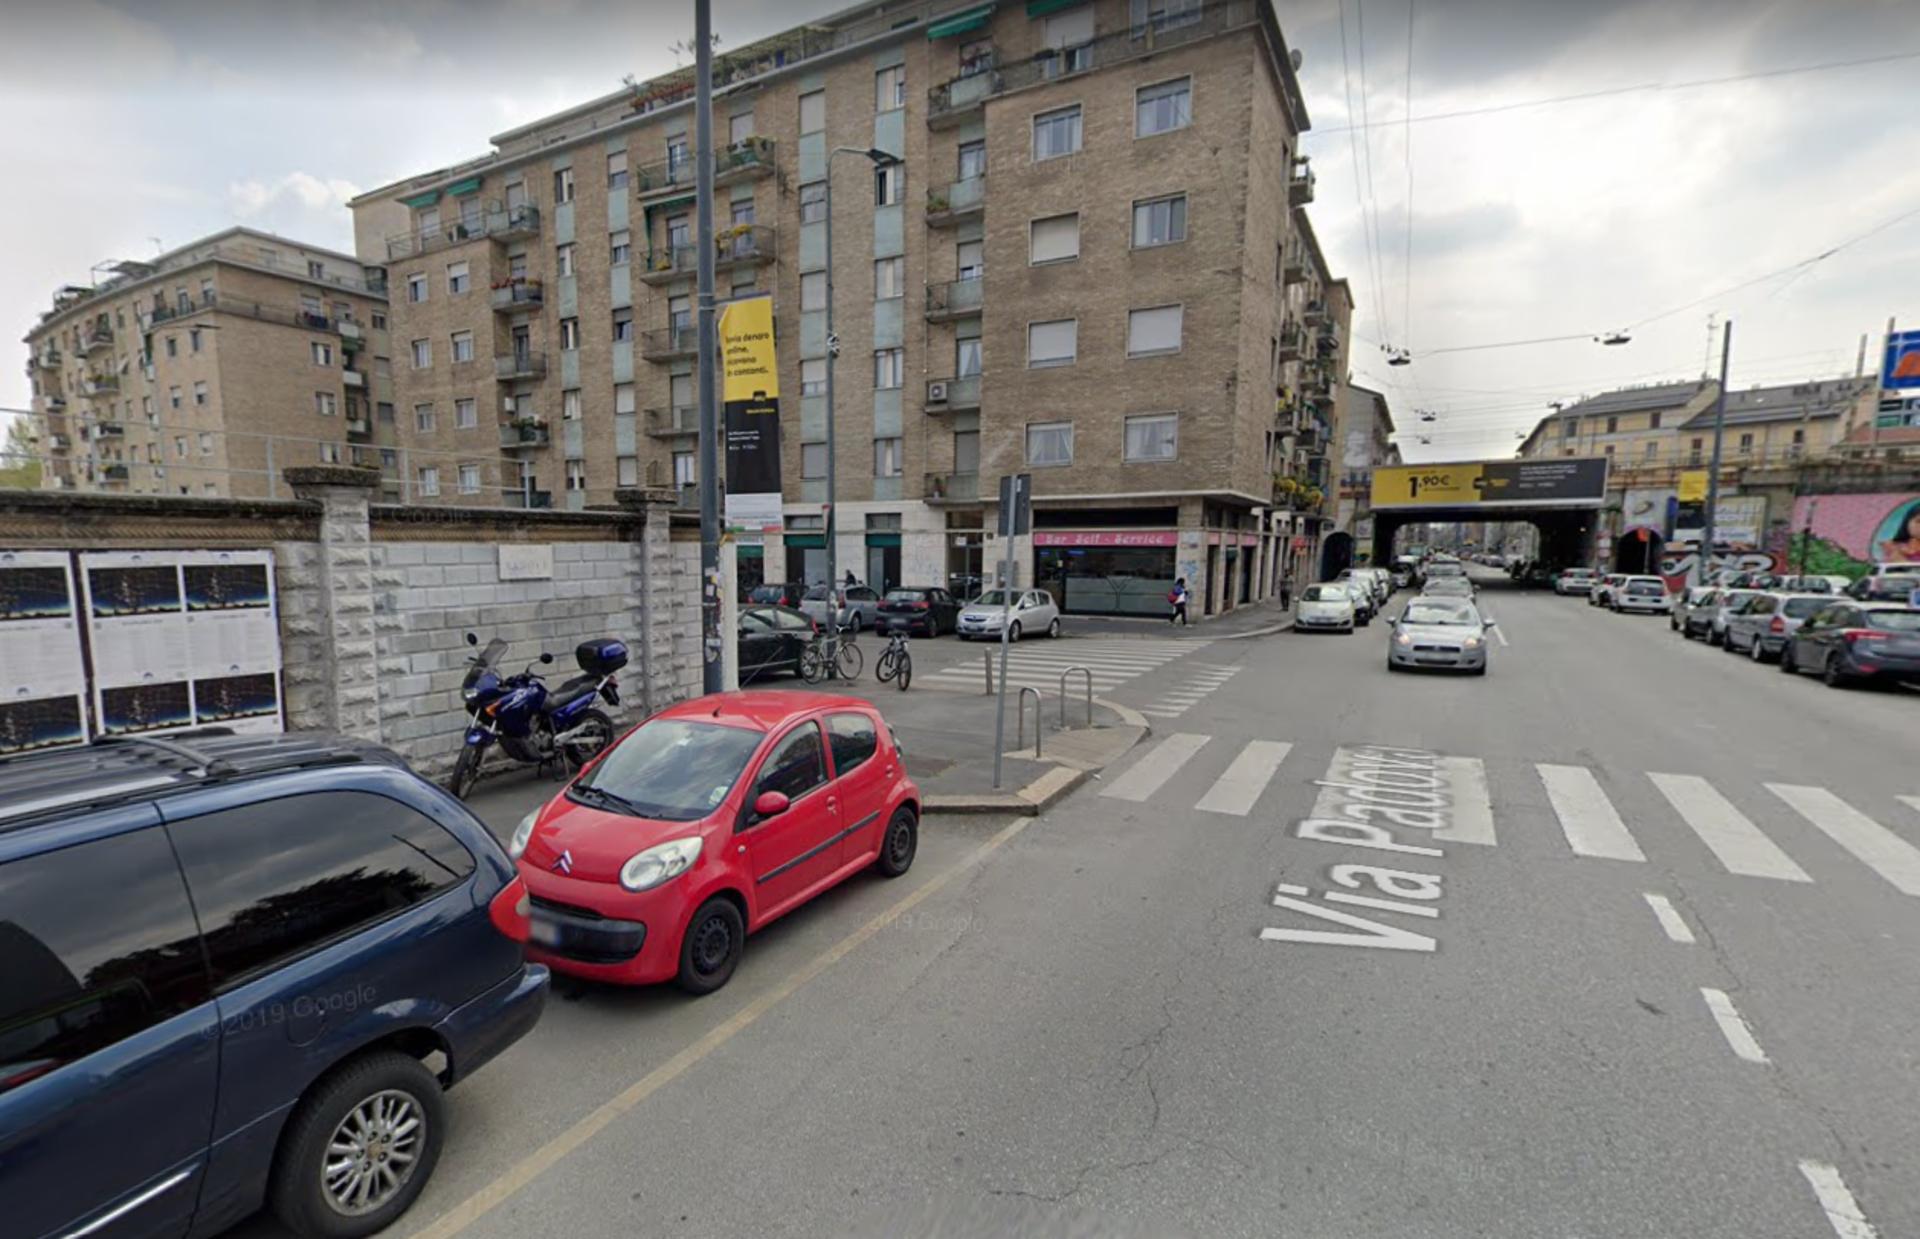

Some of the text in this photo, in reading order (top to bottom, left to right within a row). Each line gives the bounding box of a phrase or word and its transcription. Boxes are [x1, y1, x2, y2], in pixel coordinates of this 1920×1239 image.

[1045, 533, 1067, 545] Bar
[1076, 533, 1101, 544] Self
[1114, 533, 1165, 545] Service
[1259, 744, 1450, 952] Via Padova
